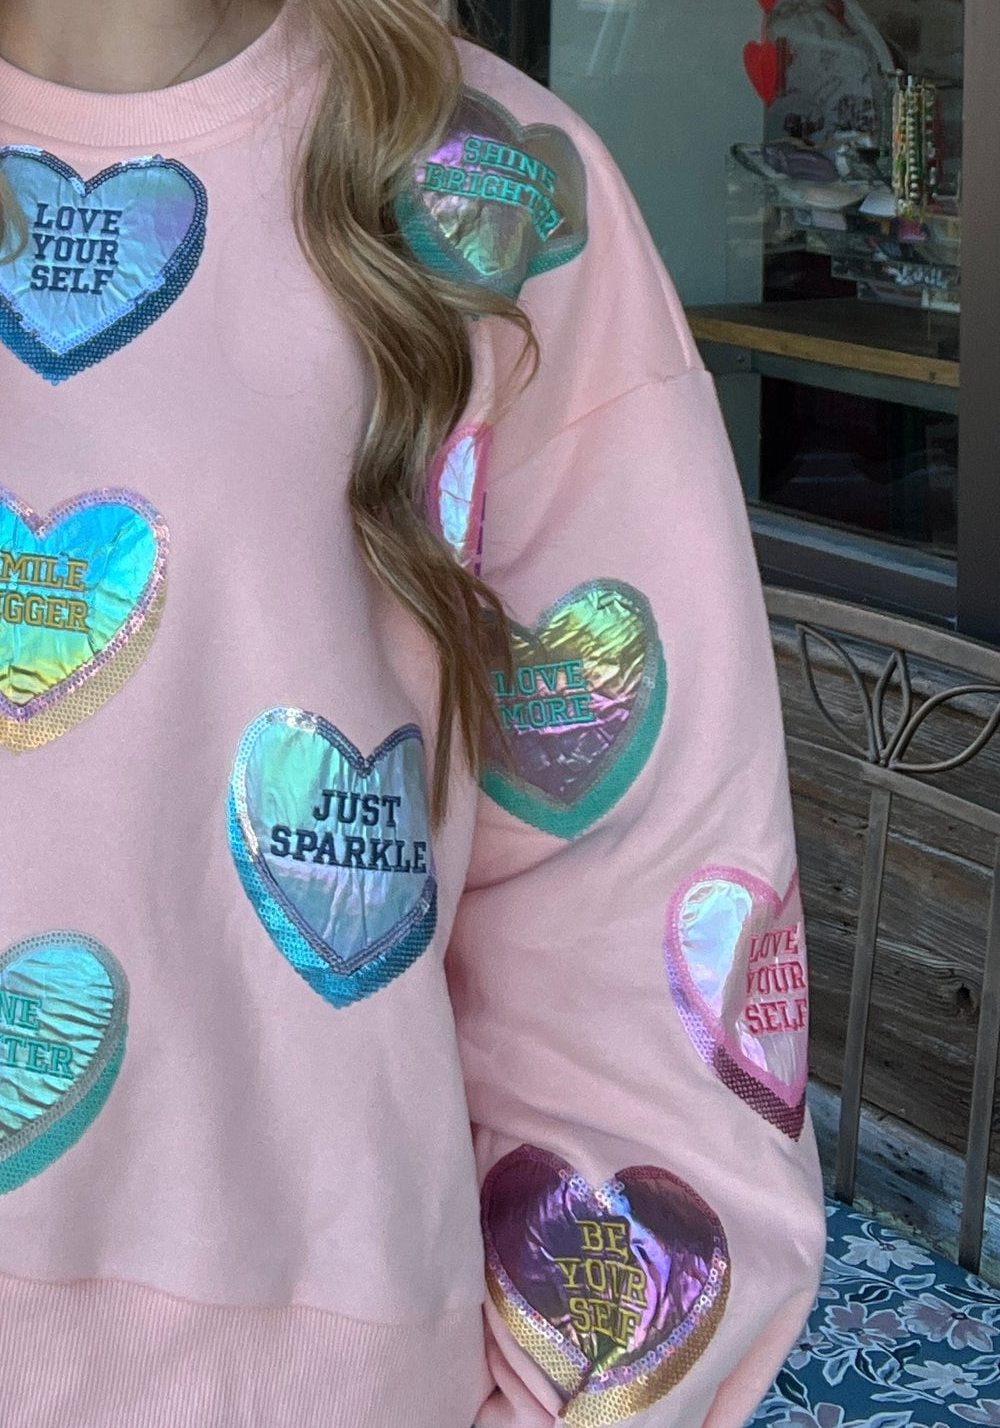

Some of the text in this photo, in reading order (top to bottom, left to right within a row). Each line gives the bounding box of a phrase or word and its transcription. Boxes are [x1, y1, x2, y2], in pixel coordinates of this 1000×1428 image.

[461, 135, 557, 196] SHINE
[33, 203, 123, 235] LOVE
[32, 233, 119, 265] YOUR
[30, 264, 114, 296] SELF
[491, 659, 587, 698] LOVE
[498, 693, 596, 731] MORE
[312, 788, 402, 828] JUST
[269, 824, 428, 874] SPARKLE
[748, 925, 800, 964] LOVE
[745, 960, 807, 998] YOUR
[745, 998, 808, 1036] SELF
[575, 1219, 630, 1262] BE
[568, 1296, 642, 1349] SEF
